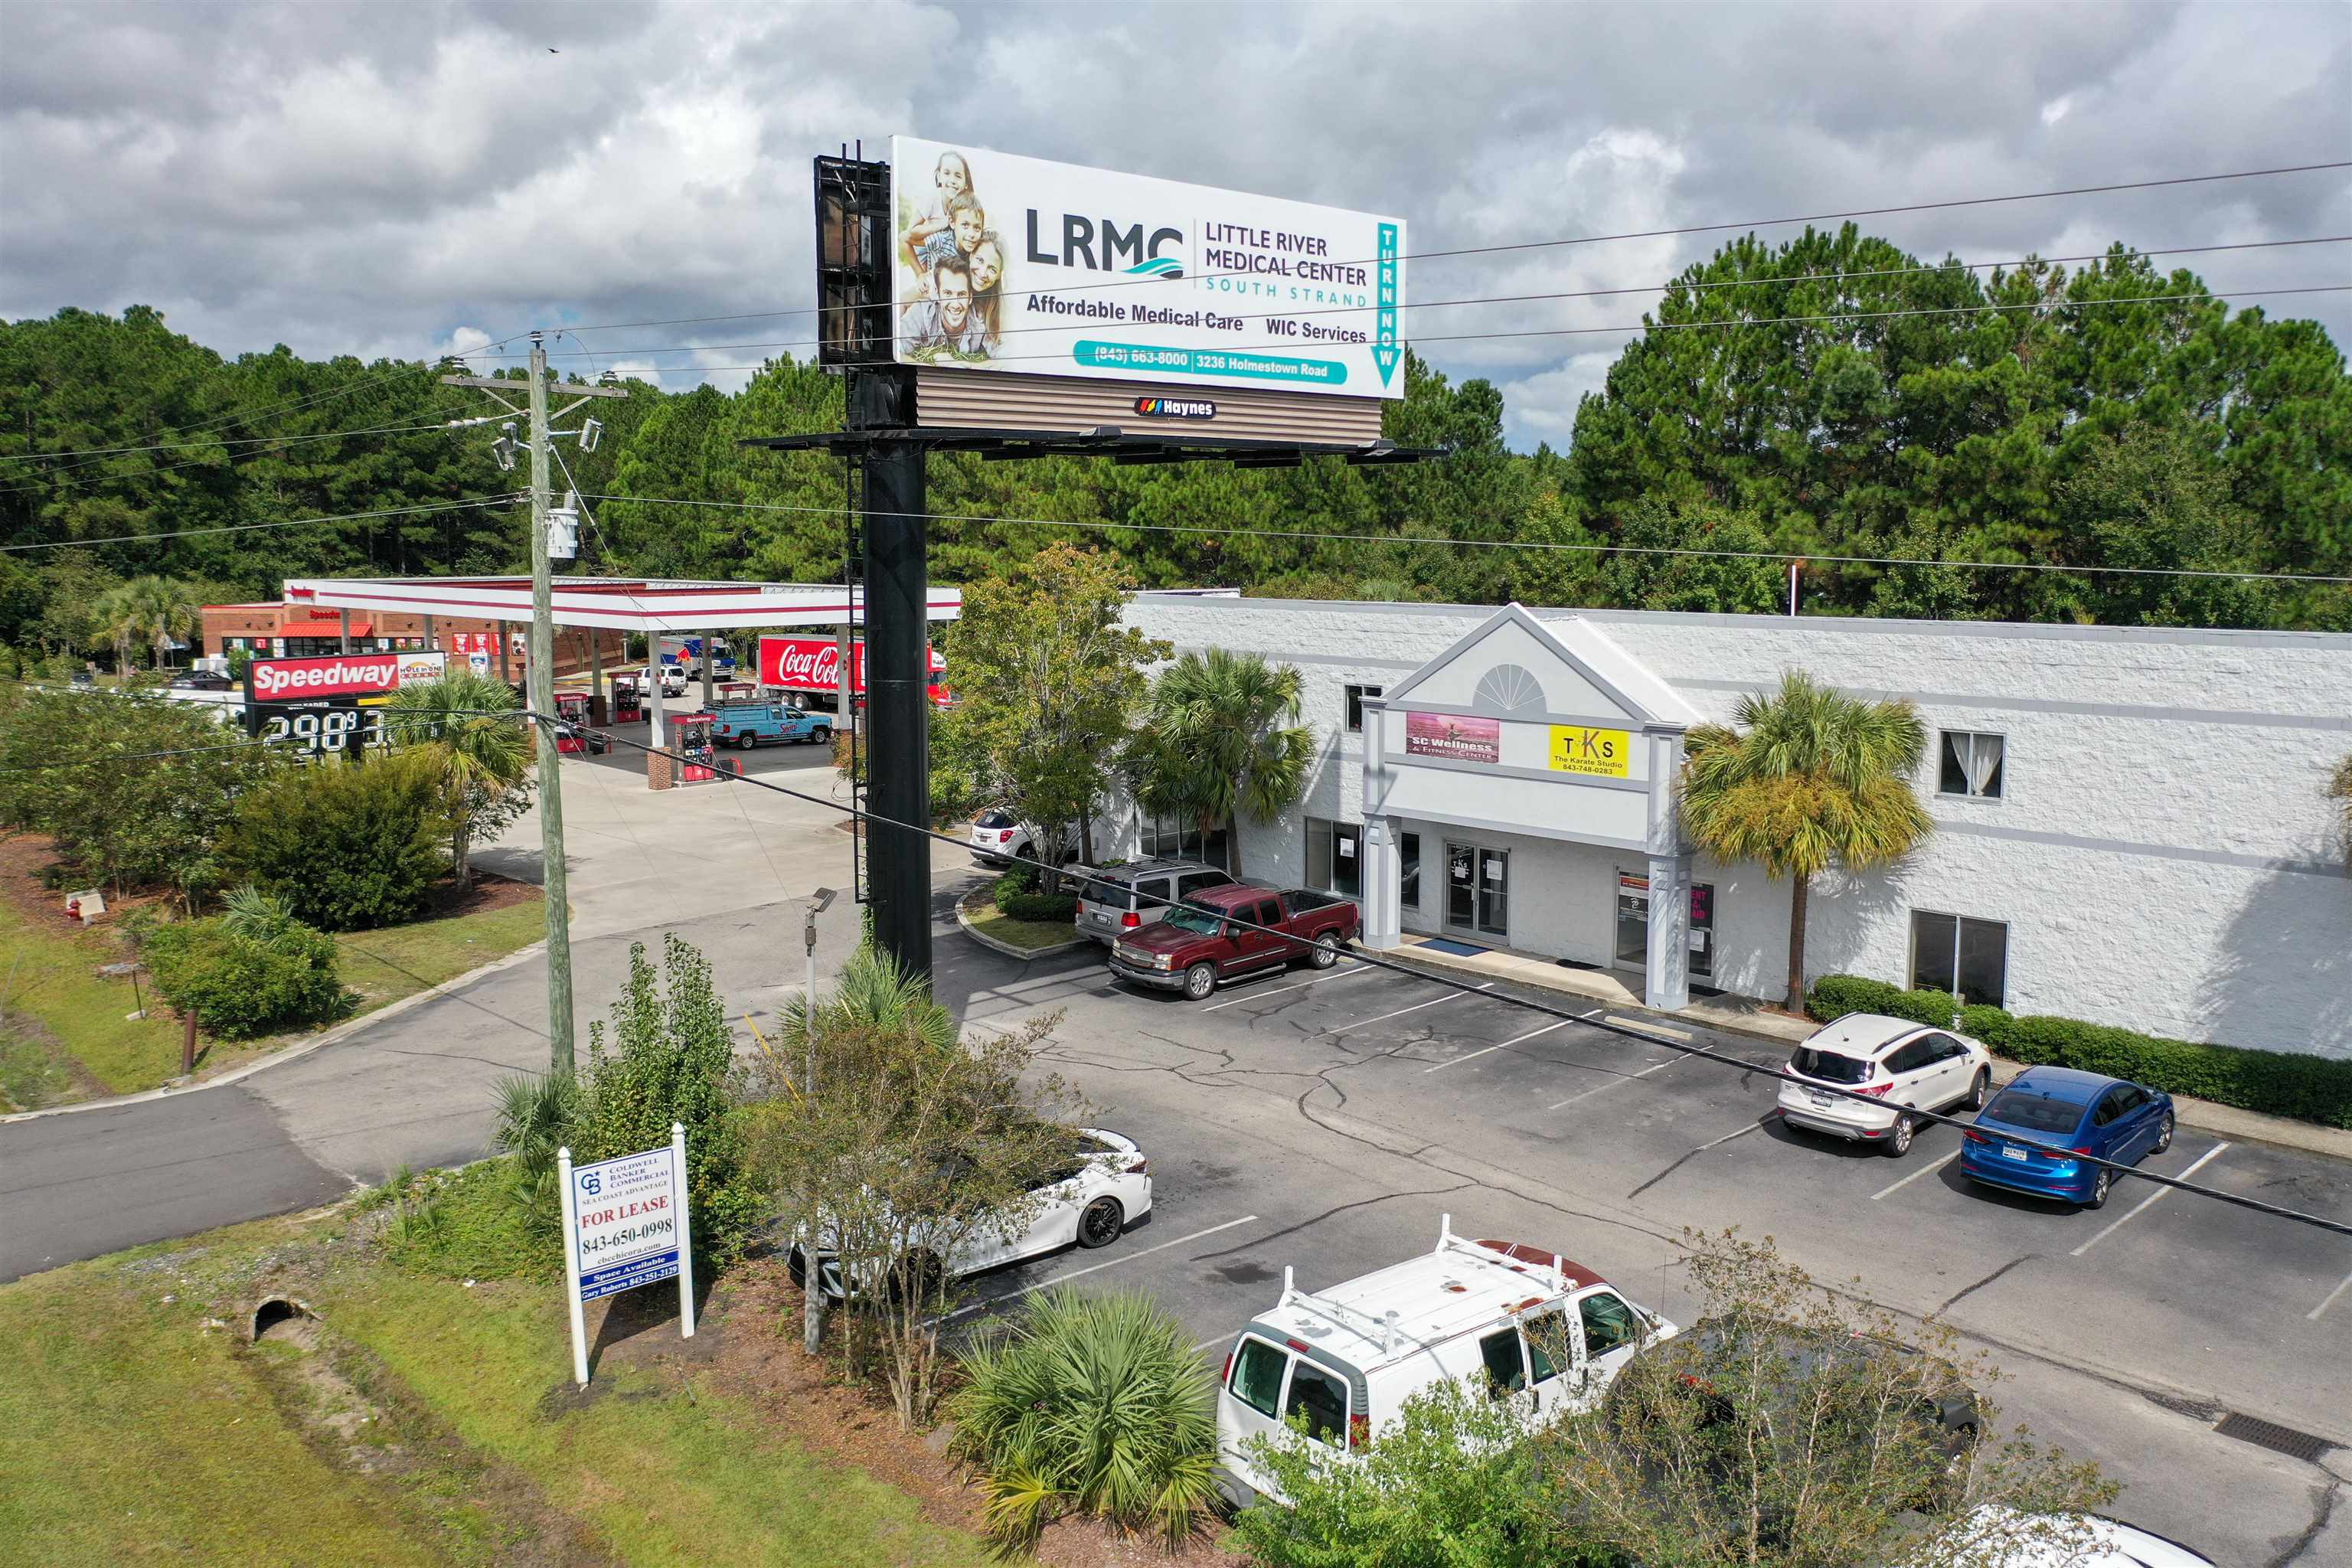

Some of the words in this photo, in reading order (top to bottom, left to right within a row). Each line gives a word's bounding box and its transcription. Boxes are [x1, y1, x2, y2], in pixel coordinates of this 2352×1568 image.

[1027, 208, 1184, 279] LRMC
[1206, 222, 1270, 249] LITTLE
[1276, 232, 1328, 256] RIVER
[1206, 248, 1292, 276] MEDICAL
[1296, 261, 1367, 286] CENTER
[1382, 230, 1393, 303] TURN
[1207, 277, 1276, 297] SOUTH
[1290, 287, 1366, 307] STRAND
[1027, 294, 1125, 320] Affordable
[1132, 305, 1199, 327] Medical
[1205, 312, 1243, 331] Care
[1266, 318, 1297, 337] WIC
[1302, 322, 1367, 342] Services
[1379, 312, 1393, 366] NOW
[1095, 347, 1127, 364] (843)
[1131, 348, 1187, 367] 663-8000
[1196, 354, 1225, 368] 3236
[1228, 358, 1298, 374] Holmestown
[1301, 364, 1328, 377] Road
[1164, 400, 1212, 416] Haynes
[779, 643, 839, 684] Coca-Col
[253, 662, 397, 694] Speedway
[1412, 737, 1429, 746] SC
[1432, 738, 1493, 752] Wellness
[1458, 750, 1492, 760] CENTER
[1563, 763, 1612, 775] 843-748-0283
[1570, 756, 1595, 766] Karate
[1597, 760, 1623, 769] Studio
[609, 1158, 659, 1174] COLDWELL
[609, 1168, 645, 1181] BANKER
[610, 1170, 670, 1188] COMMERCIAL
[582, 1197, 596, 1207] SEA
[598, 1191, 622, 1202] COAST
[624, 1180, 668, 1195] ADVANTAGE
[581, 1210, 615, 1229] FOR
[619, 1195, 668, 1220] LEASE
[583, 1218, 672, 1255] 843-650-0998
[582, 1289, 599, 1299] Gary
[600, 1281, 628, 1294] Roberts
[629, 1266, 678, 1286] 843-251-2129
[593, 1270, 621, 1282] Space
[622, 1257, 666, 1273] Available
